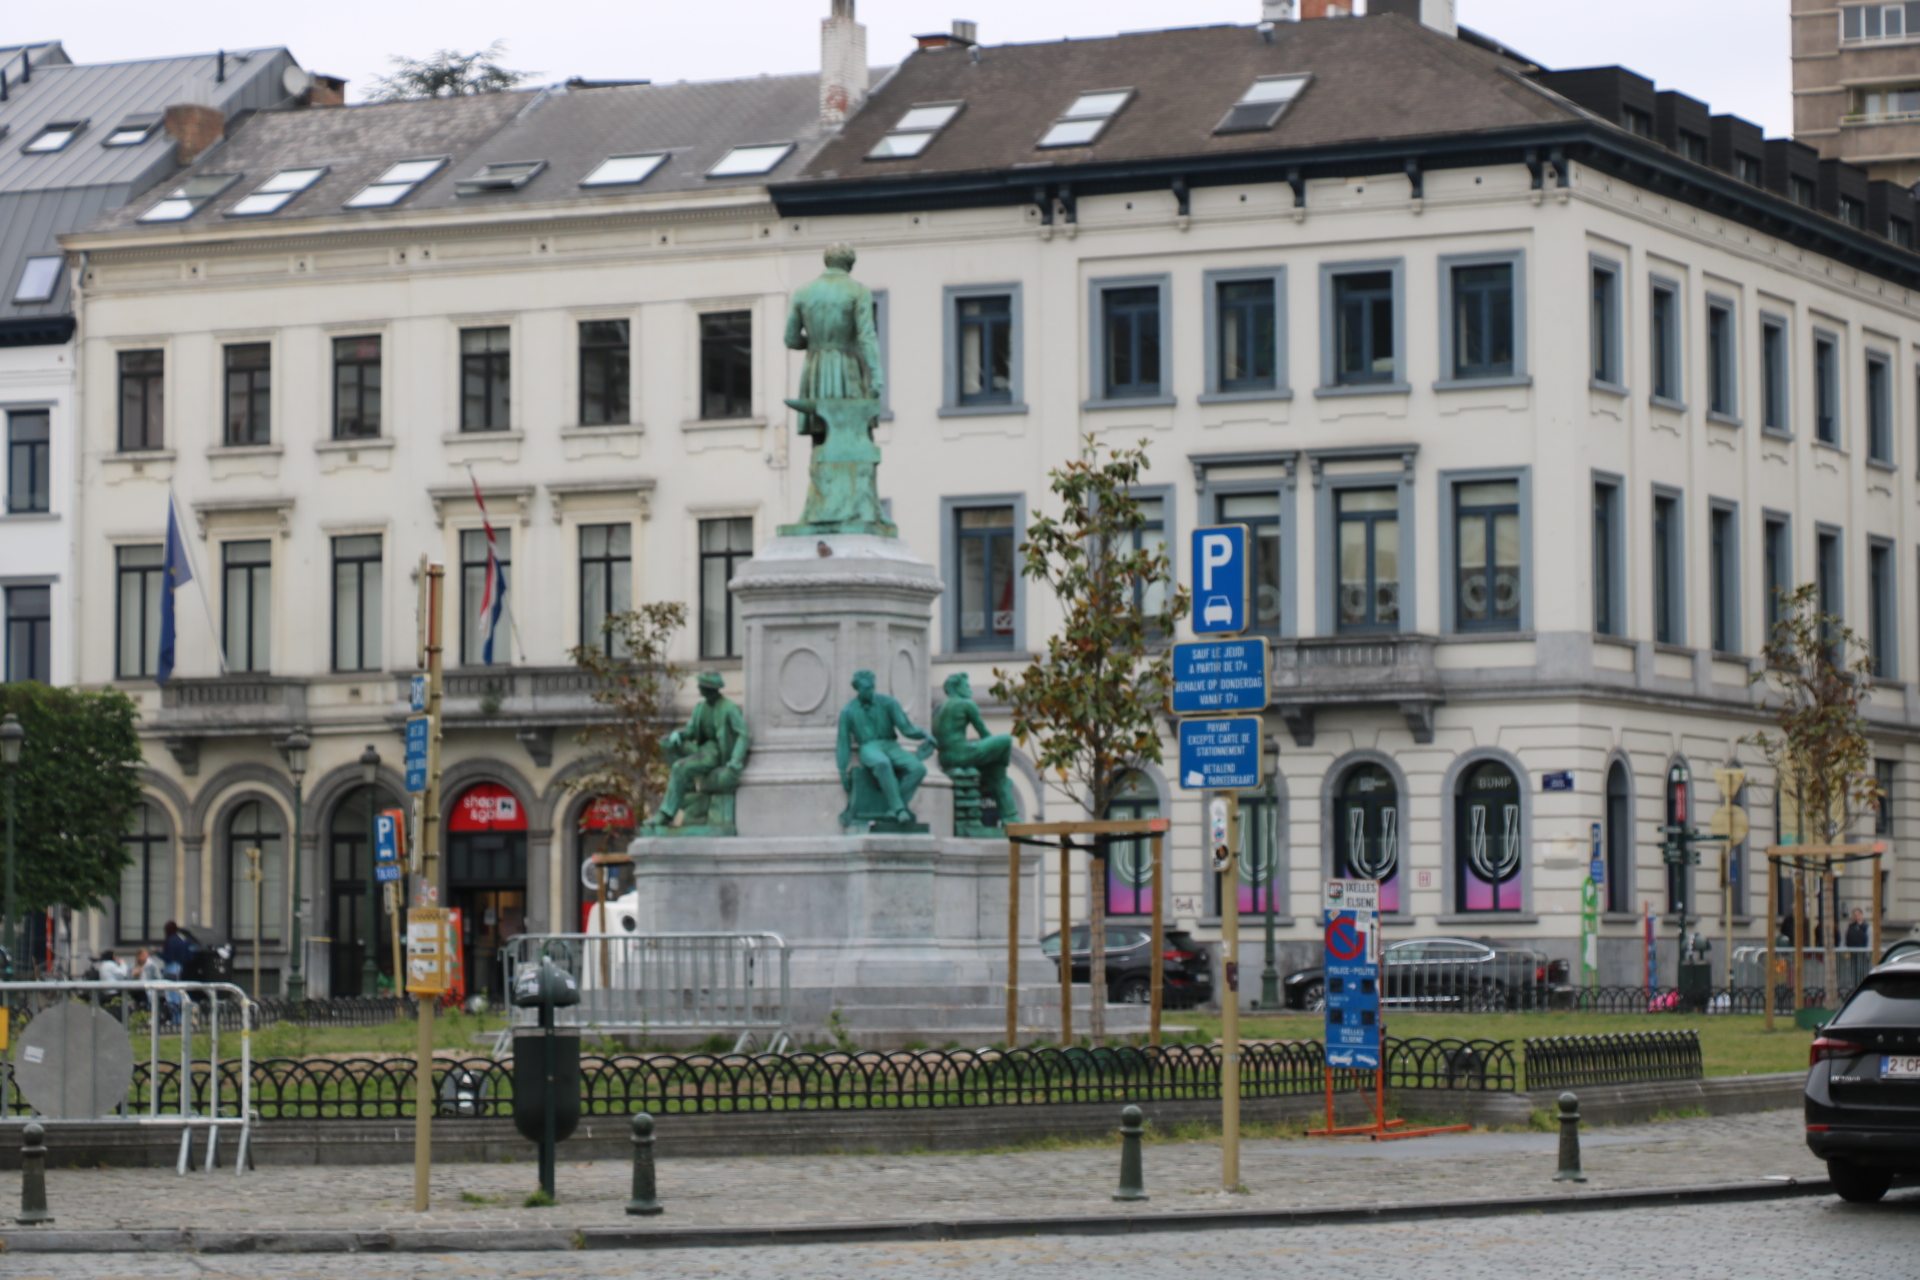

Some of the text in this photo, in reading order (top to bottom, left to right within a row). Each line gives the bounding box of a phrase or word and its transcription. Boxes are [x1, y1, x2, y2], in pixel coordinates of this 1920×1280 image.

[1203, 534, 1233, 590] P
[1192, 646, 1245, 660] SAUF LE JEUDI
[1189, 664, 1194, 674] A
[1197, 662, 1221, 673] PARTIR
[1224, 662, 1233, 672] DE
[1176, 677, 1263, 692] BEHALVE OP DONDERDAG
[1200, 694, 1223, 705] VANAF
[1207, 722, 1231, 732] PAYANT
[1188, 733, 1250, 746] EXCEPTE CARTE DE
[1197, 745, 1245, 757] STATIONNEMENT
[1204, 763, 1236, 774] BETALEND
[1209, 774, 1254, 786] PARKEERKAART
[1479, 777, 1512, 789] BUMP
[463, 794, 494, 809] shop
[471, 808, 495, 823] &go
[378, 819, 391, 843] P
[376, 868, 398, 880] TAXIS
[1346, 883, 1377, 894] IXELLES
[1347, 898, 1376, 908] ELSENE
